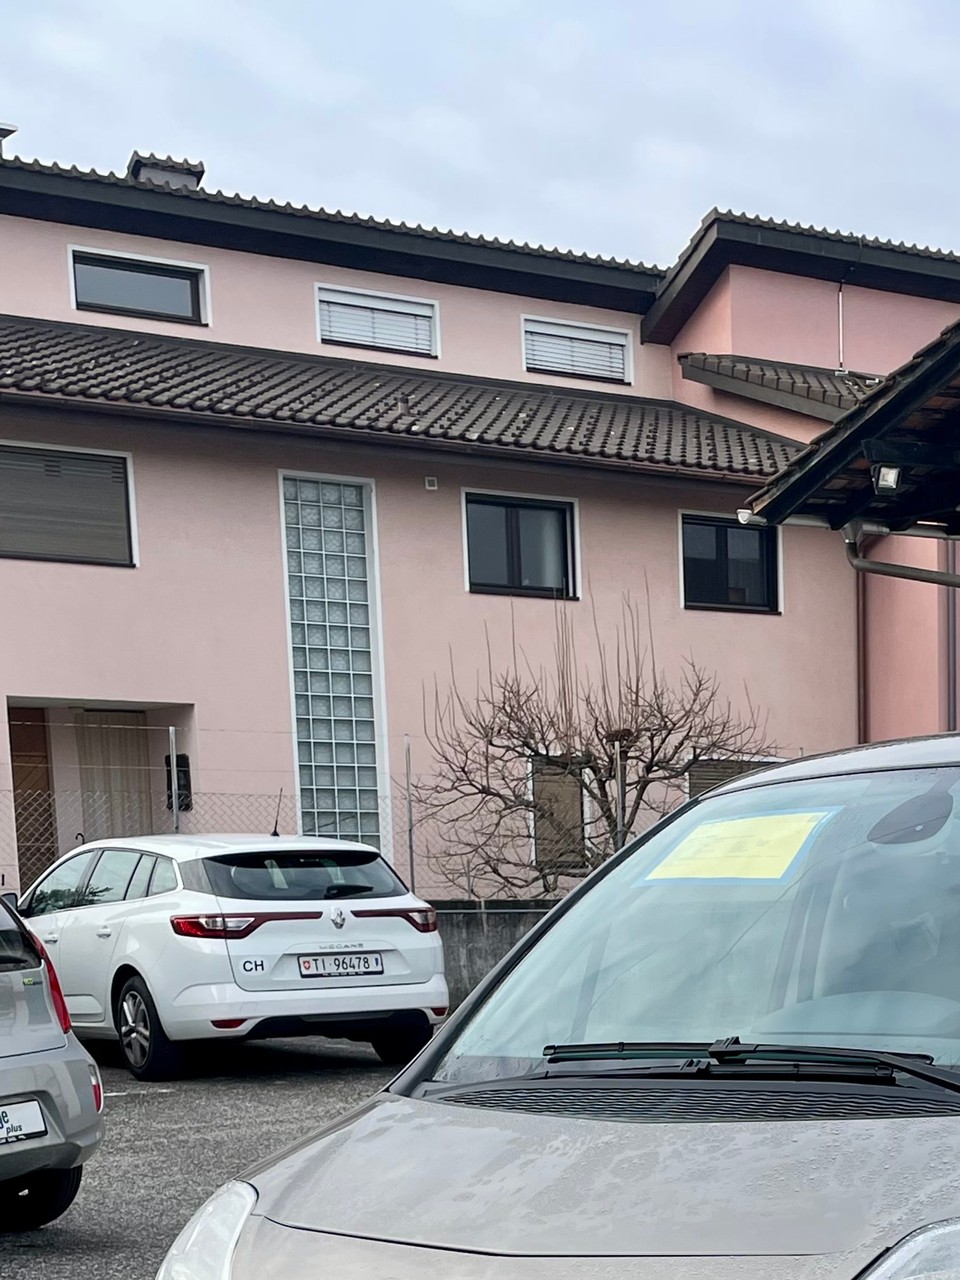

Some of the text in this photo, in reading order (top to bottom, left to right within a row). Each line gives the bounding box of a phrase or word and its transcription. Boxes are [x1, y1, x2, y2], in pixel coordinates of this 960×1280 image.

[243, 960, 264, 972] CH
[312, 956, 370, 971] TI 96478
